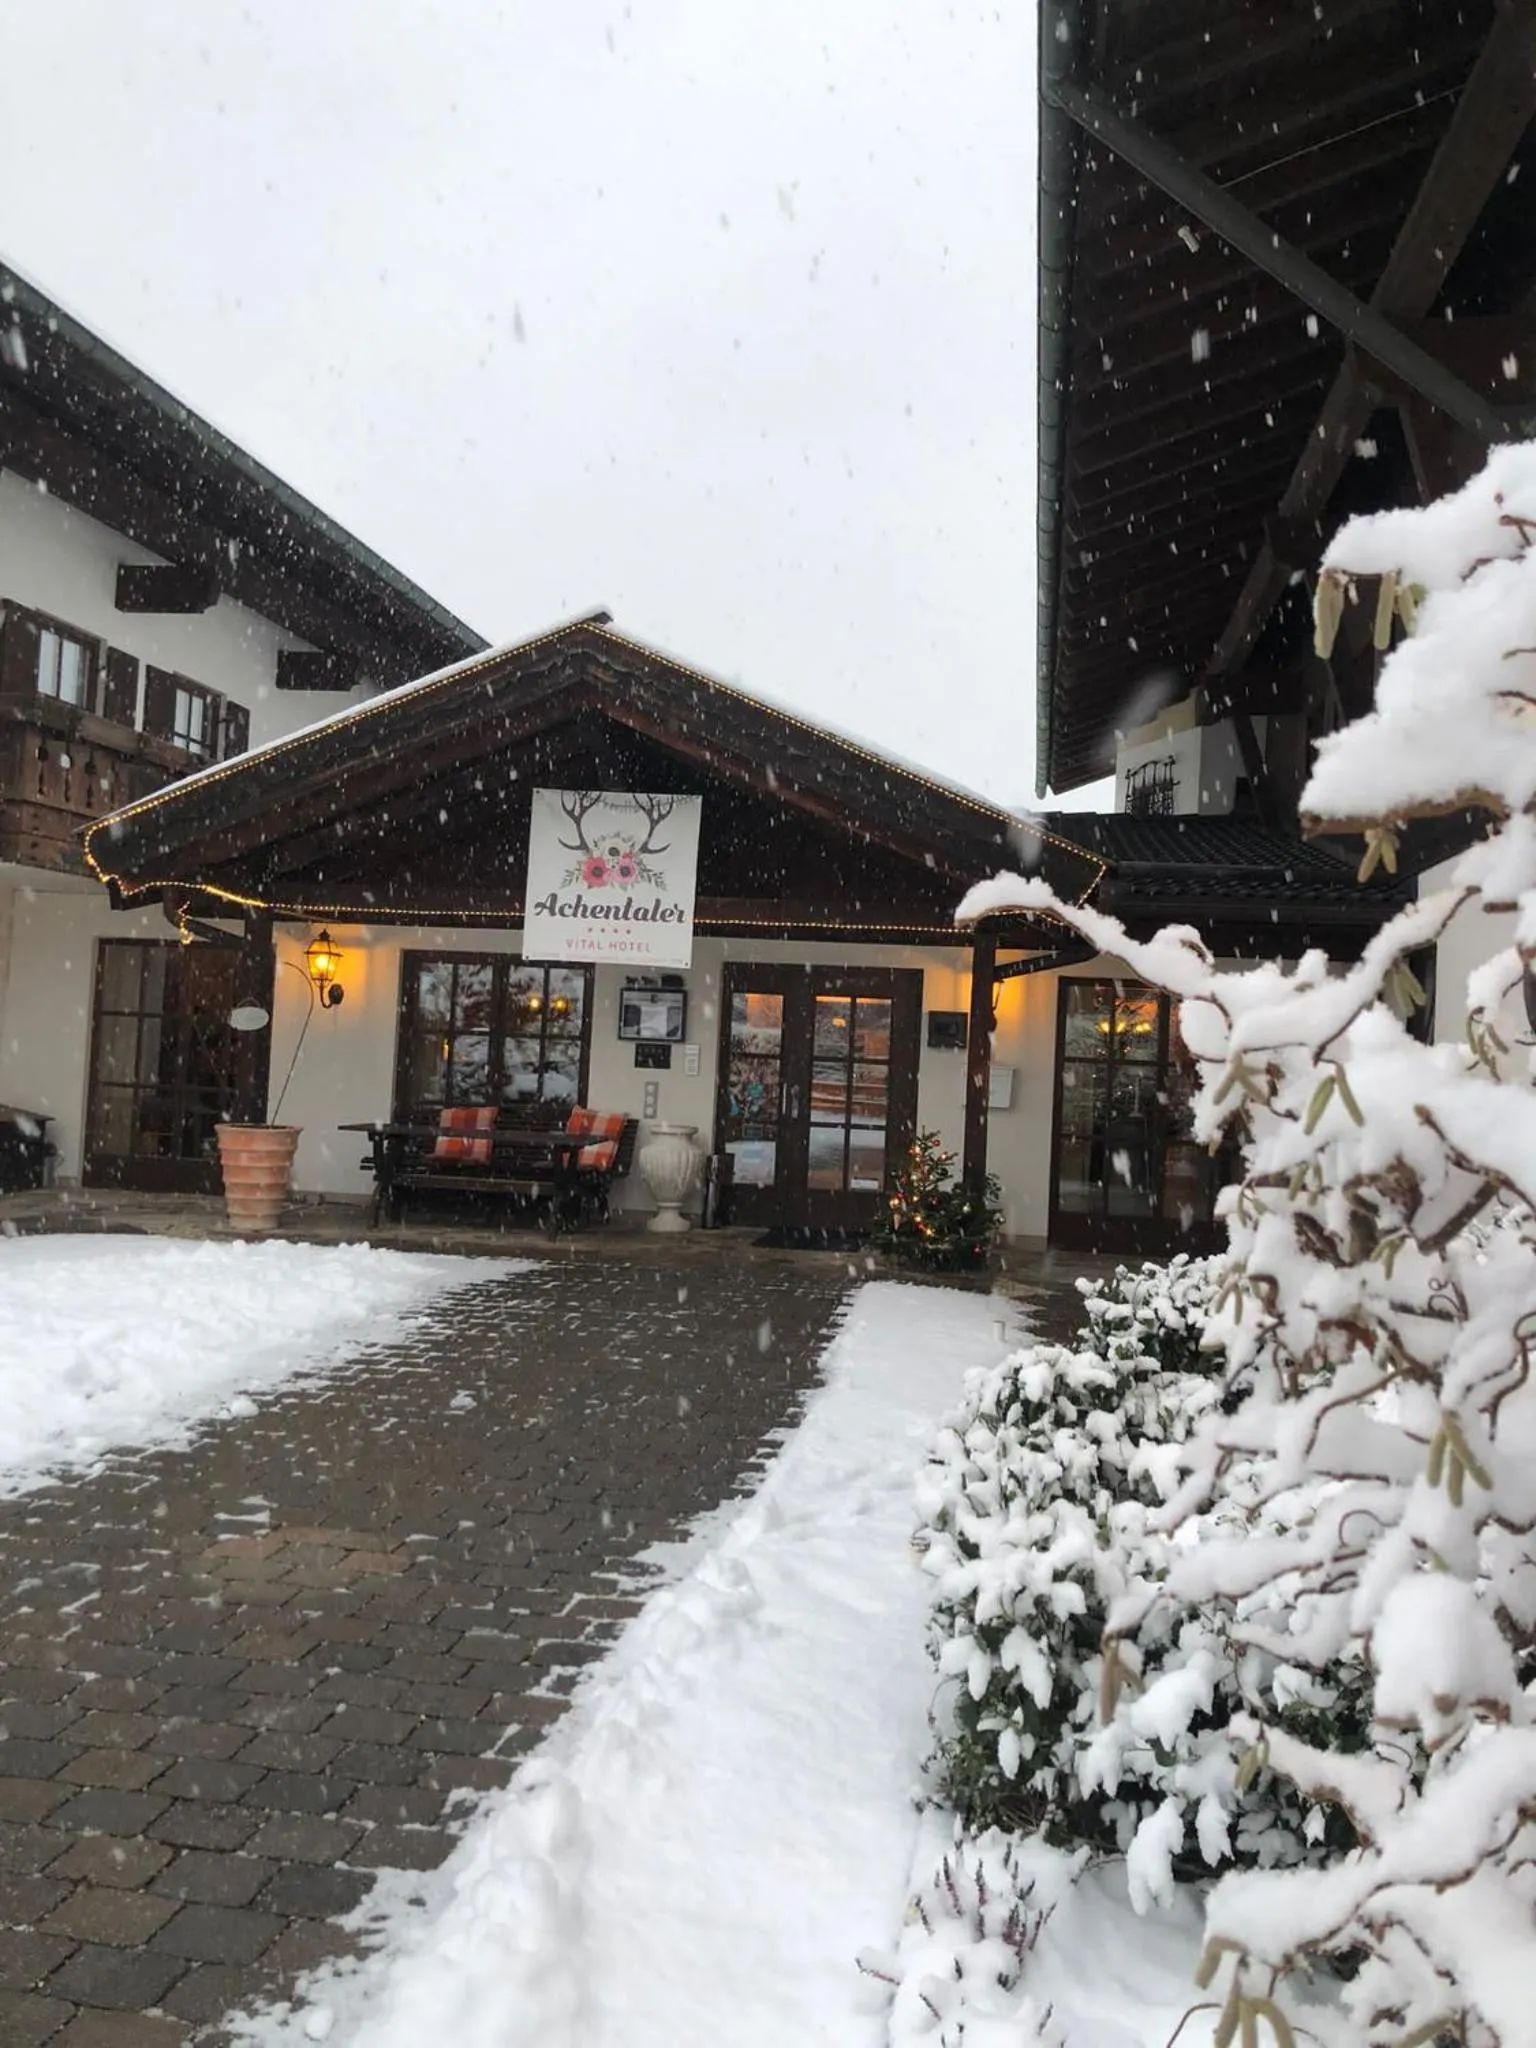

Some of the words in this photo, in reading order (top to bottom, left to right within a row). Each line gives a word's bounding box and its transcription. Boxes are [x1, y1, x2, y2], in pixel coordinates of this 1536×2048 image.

[534, 892, 685, 923] Achentaler
[565, 938, 603, 950] VITAL
[608, 941, 651, 953] HOTEL
